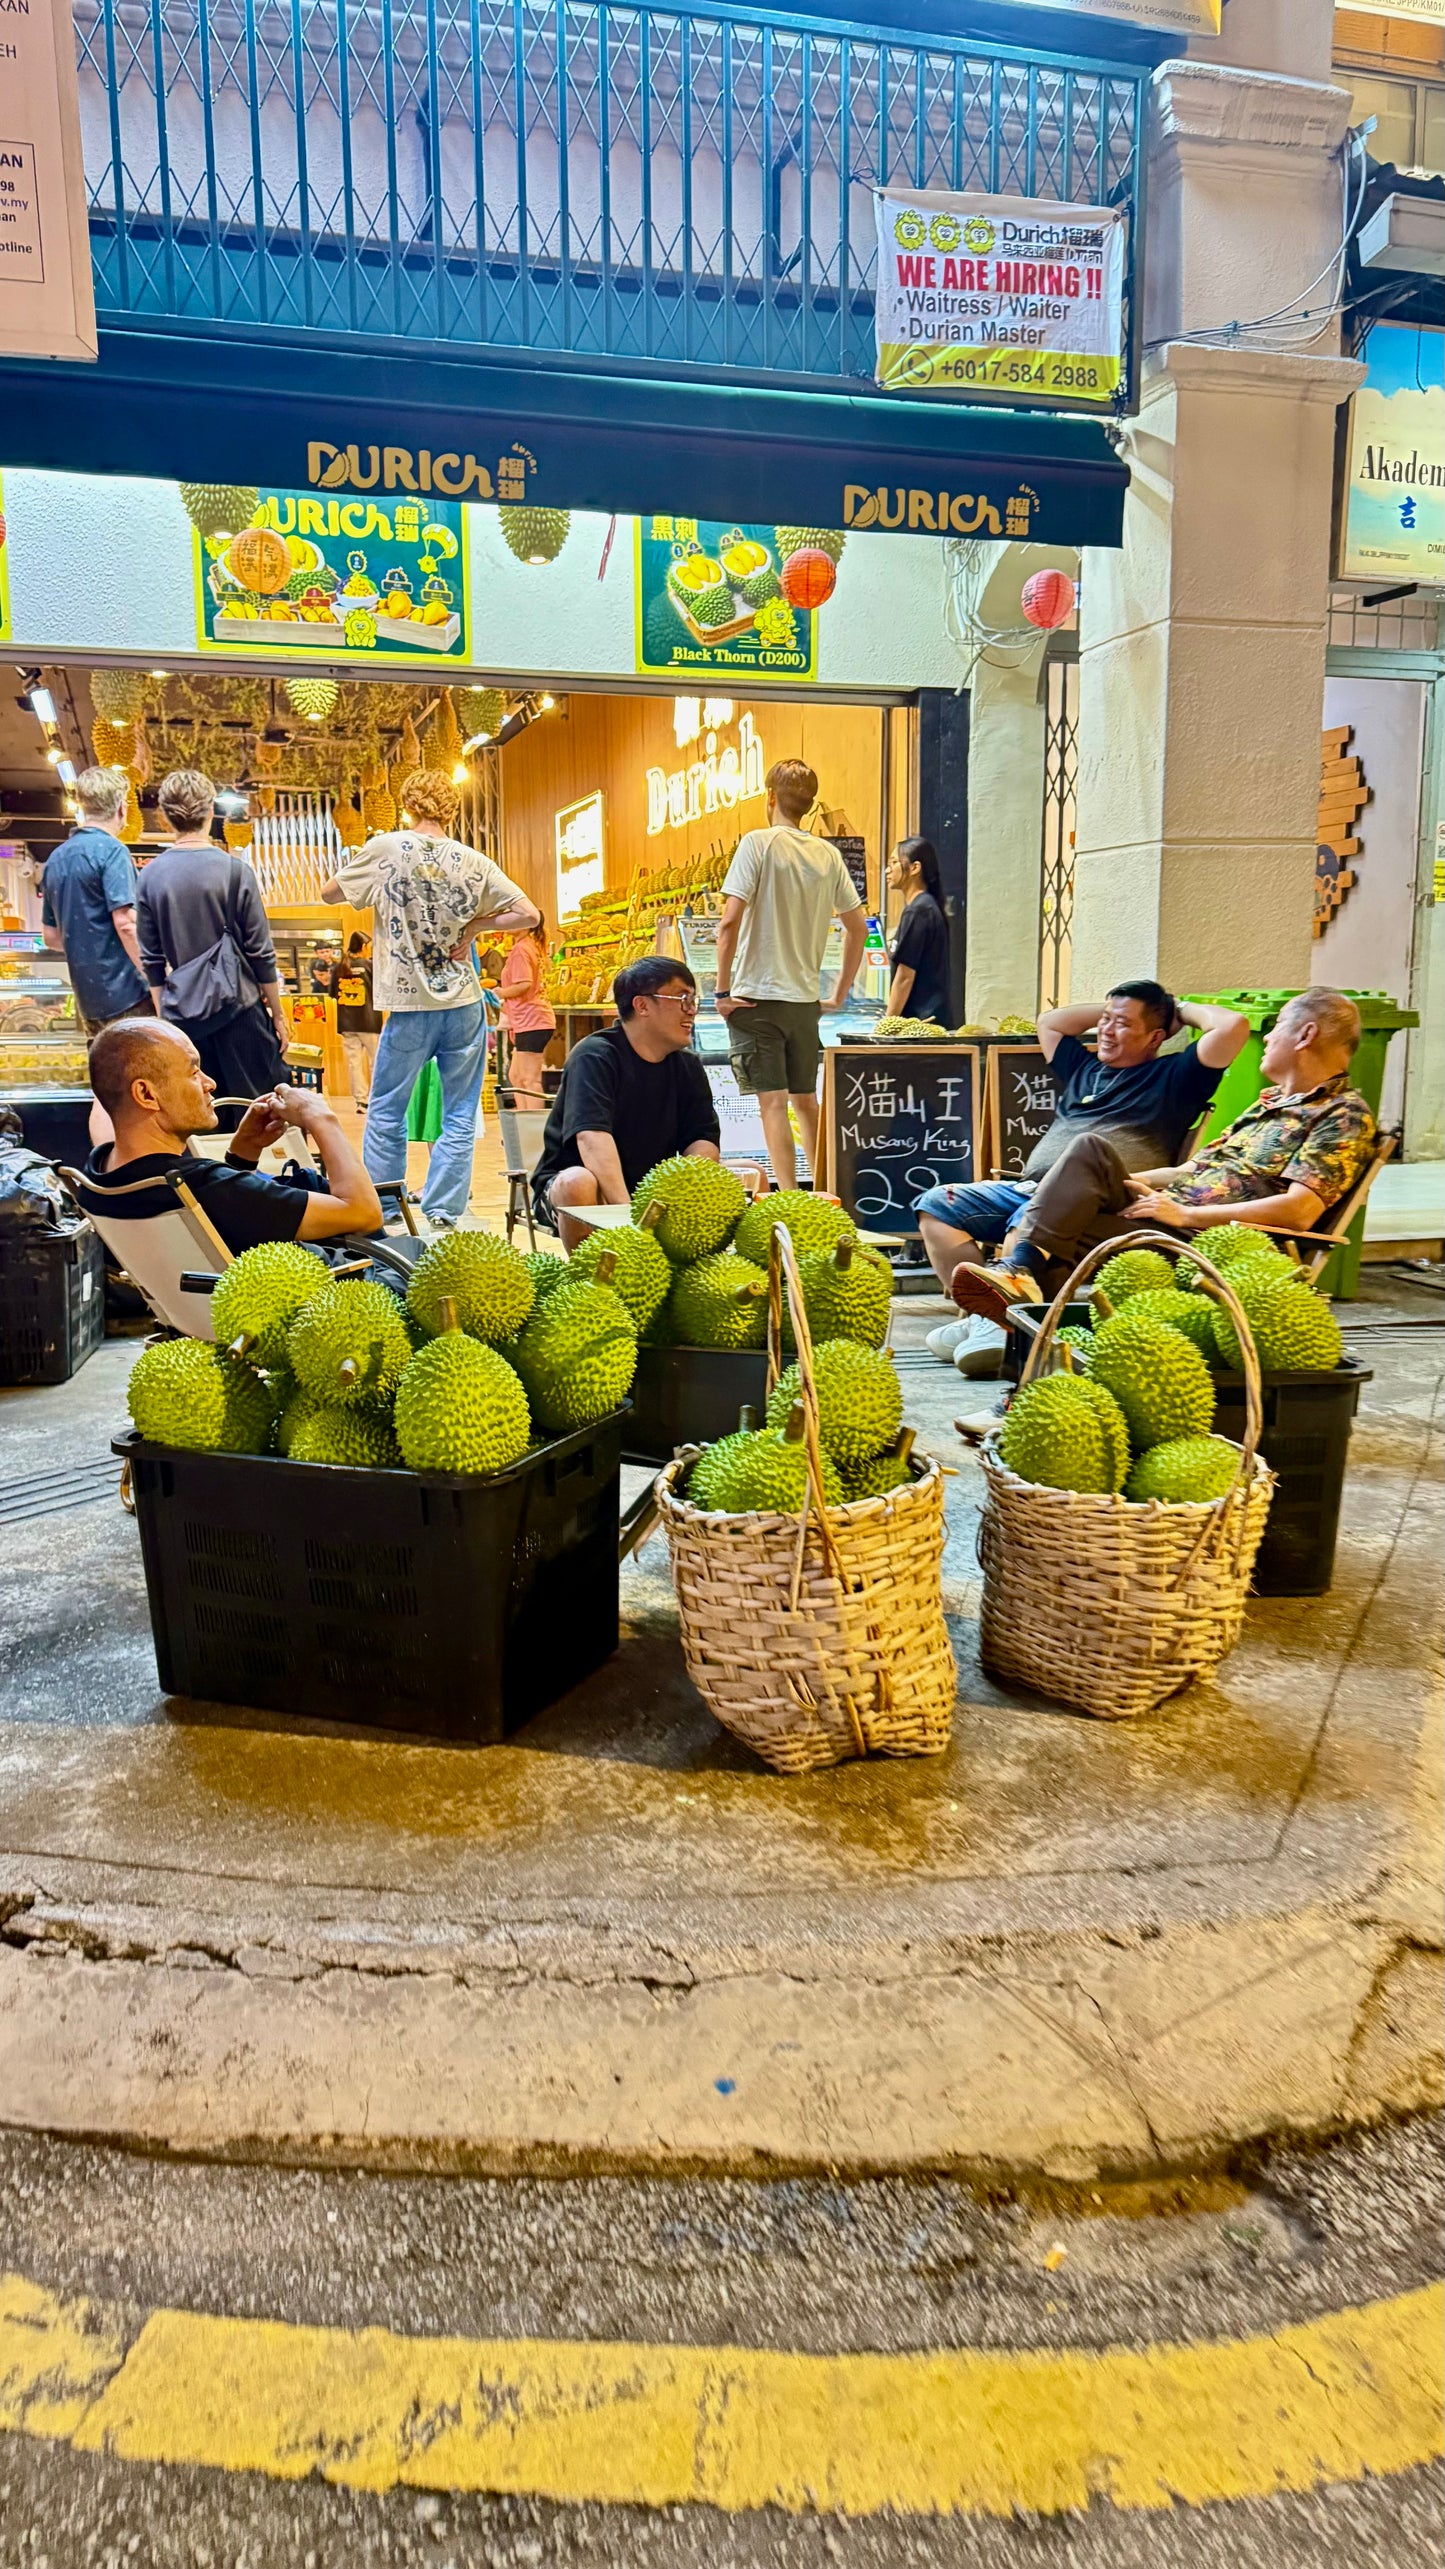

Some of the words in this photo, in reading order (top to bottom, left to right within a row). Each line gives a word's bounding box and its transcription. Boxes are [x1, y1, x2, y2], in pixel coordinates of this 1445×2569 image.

[1003, 222, 1060, 244] Durich
[896, 255, 936, 288] WE
[943, 258, 990, 292] ARE
[995, 261, 1080, 297] HIRING
[1087, 268, 1102, 300] !!
[906, 290, 991, 316] Waitress
[996, 297, 1004, 316] /
[1010, 296, 1071, 320] Waiter
[909, 317, 974, 341] Durian
[981, 322, 1046, 344] Master
[941, 360, 1045, 384] +6017-584
[1052, 366, 1098, 387] 2988
[1398, 496, 1417, 528] 吉
[672, 645, 712, 663] Black
[714, 648, 756, 666] Thorn
[758, 650, 806, 669] (D200)
[646, 711, 766, 836] Durich
[845, 1072, 964, 1123] 猫山王
[841, 1124, 918, 1160] Musang
[923, 1127, 971, 1162] King
